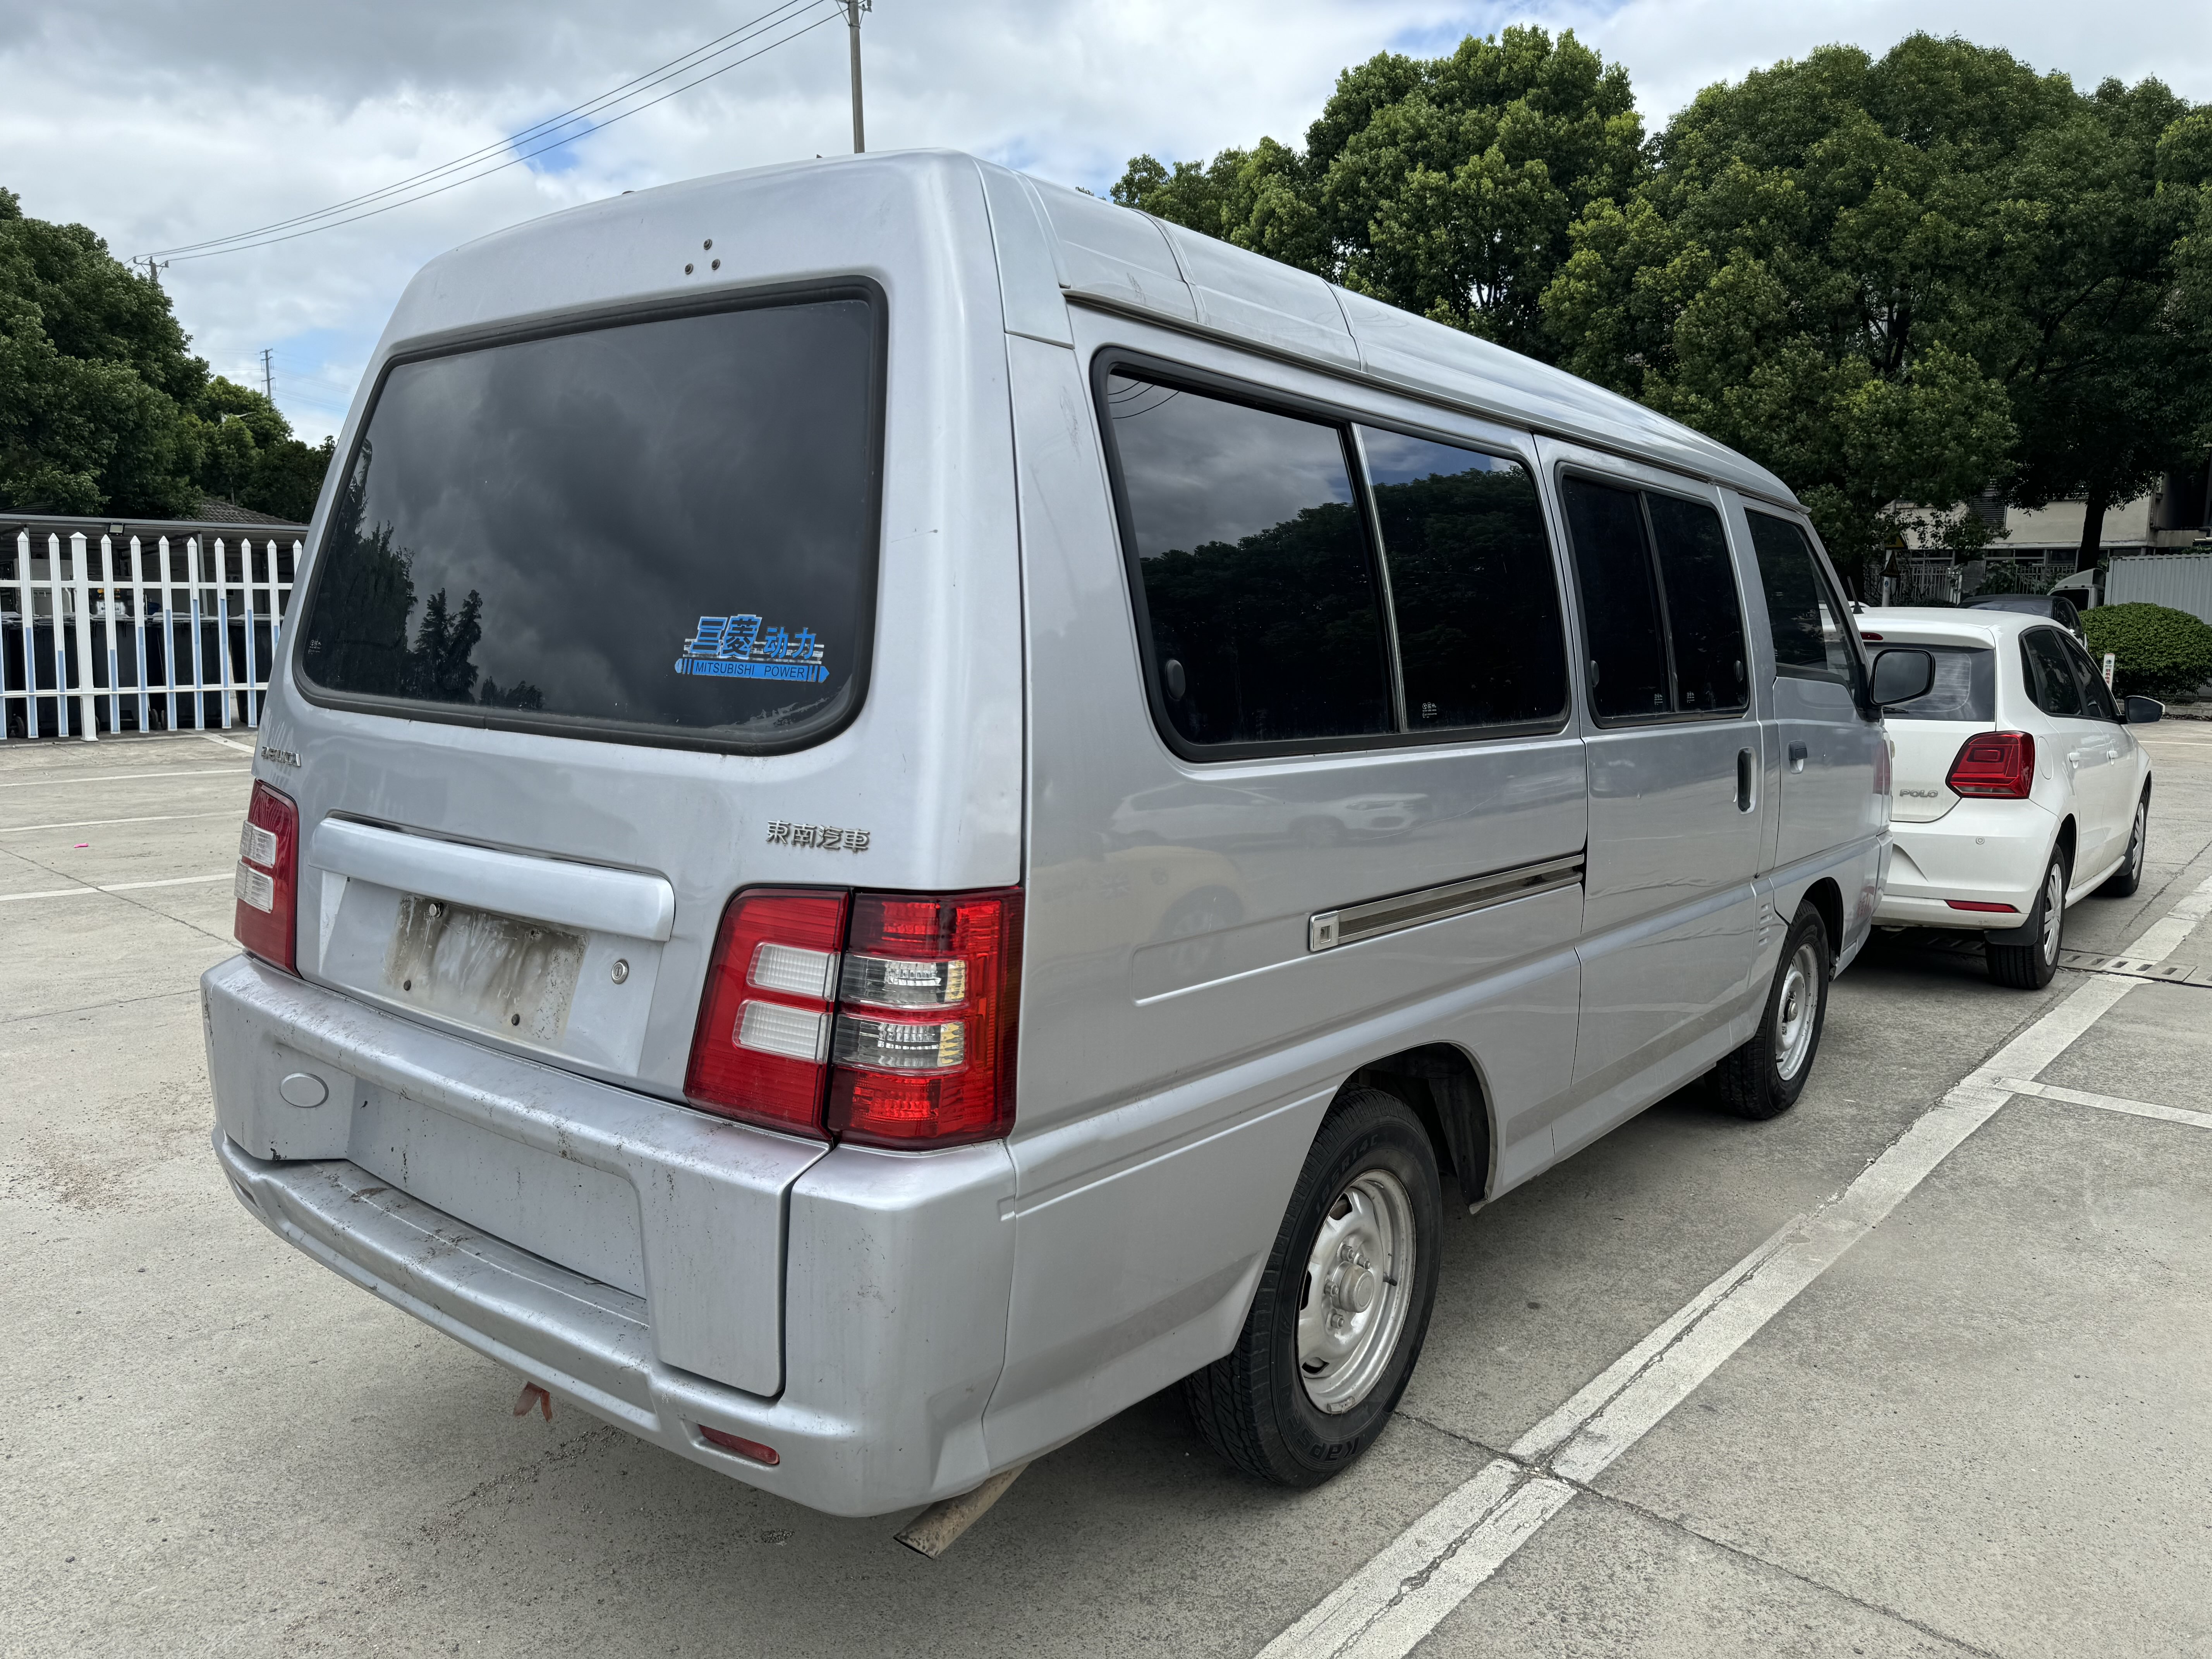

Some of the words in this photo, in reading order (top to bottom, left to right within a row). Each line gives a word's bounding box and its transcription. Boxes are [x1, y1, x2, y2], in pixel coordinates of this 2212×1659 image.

[689, 614, 816, 659] 三菱动力
[696, 662, 755, 676] MITSUBISHI
[764, 666, 805, 678] POWER
[1899, 789, 1938, 797] POLO
[765, 820, 870, 854] 東南汽車
